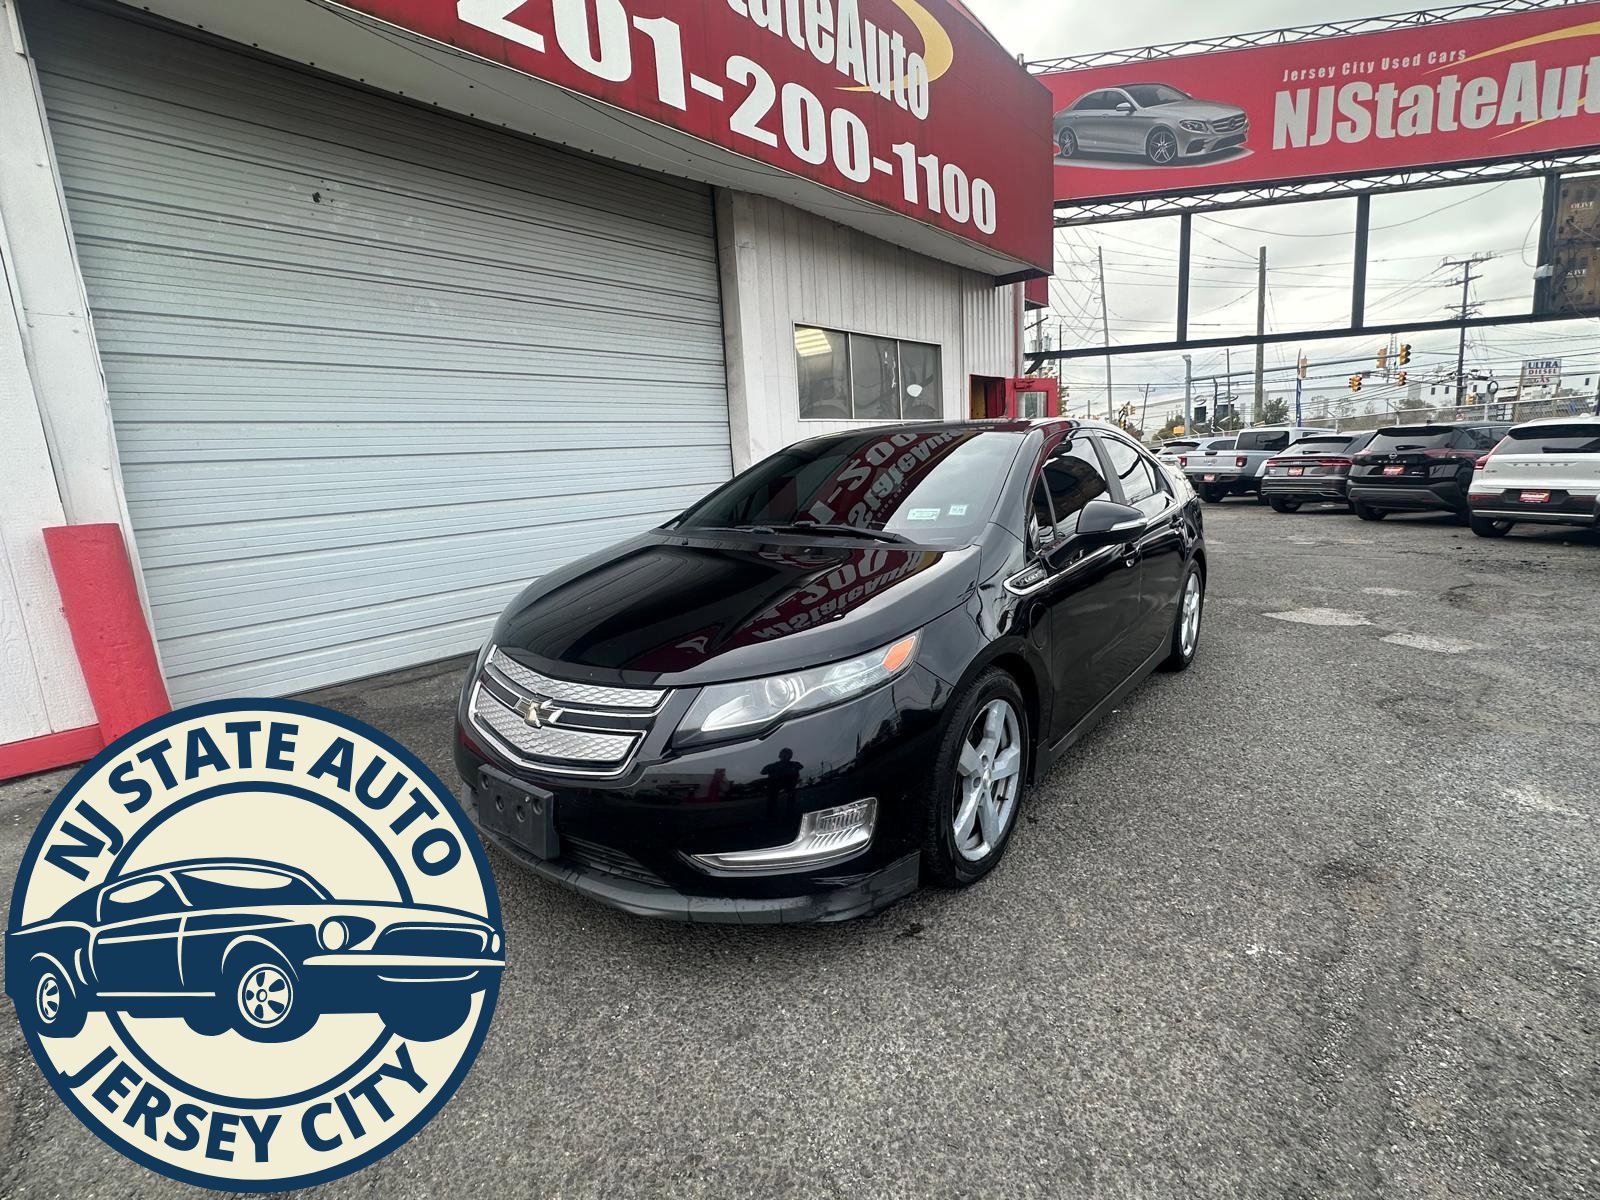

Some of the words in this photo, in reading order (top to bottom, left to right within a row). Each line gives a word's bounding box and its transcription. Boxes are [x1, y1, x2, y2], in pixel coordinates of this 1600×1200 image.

[1282, 66, 1336, 82] Jersey
[1341, 60, 1375, 76] City
[1381, 53, 1421, 71] Used
[1427, 49, 1467, 65] Cars
[1528, 361, 1559, 369] ULTRA
